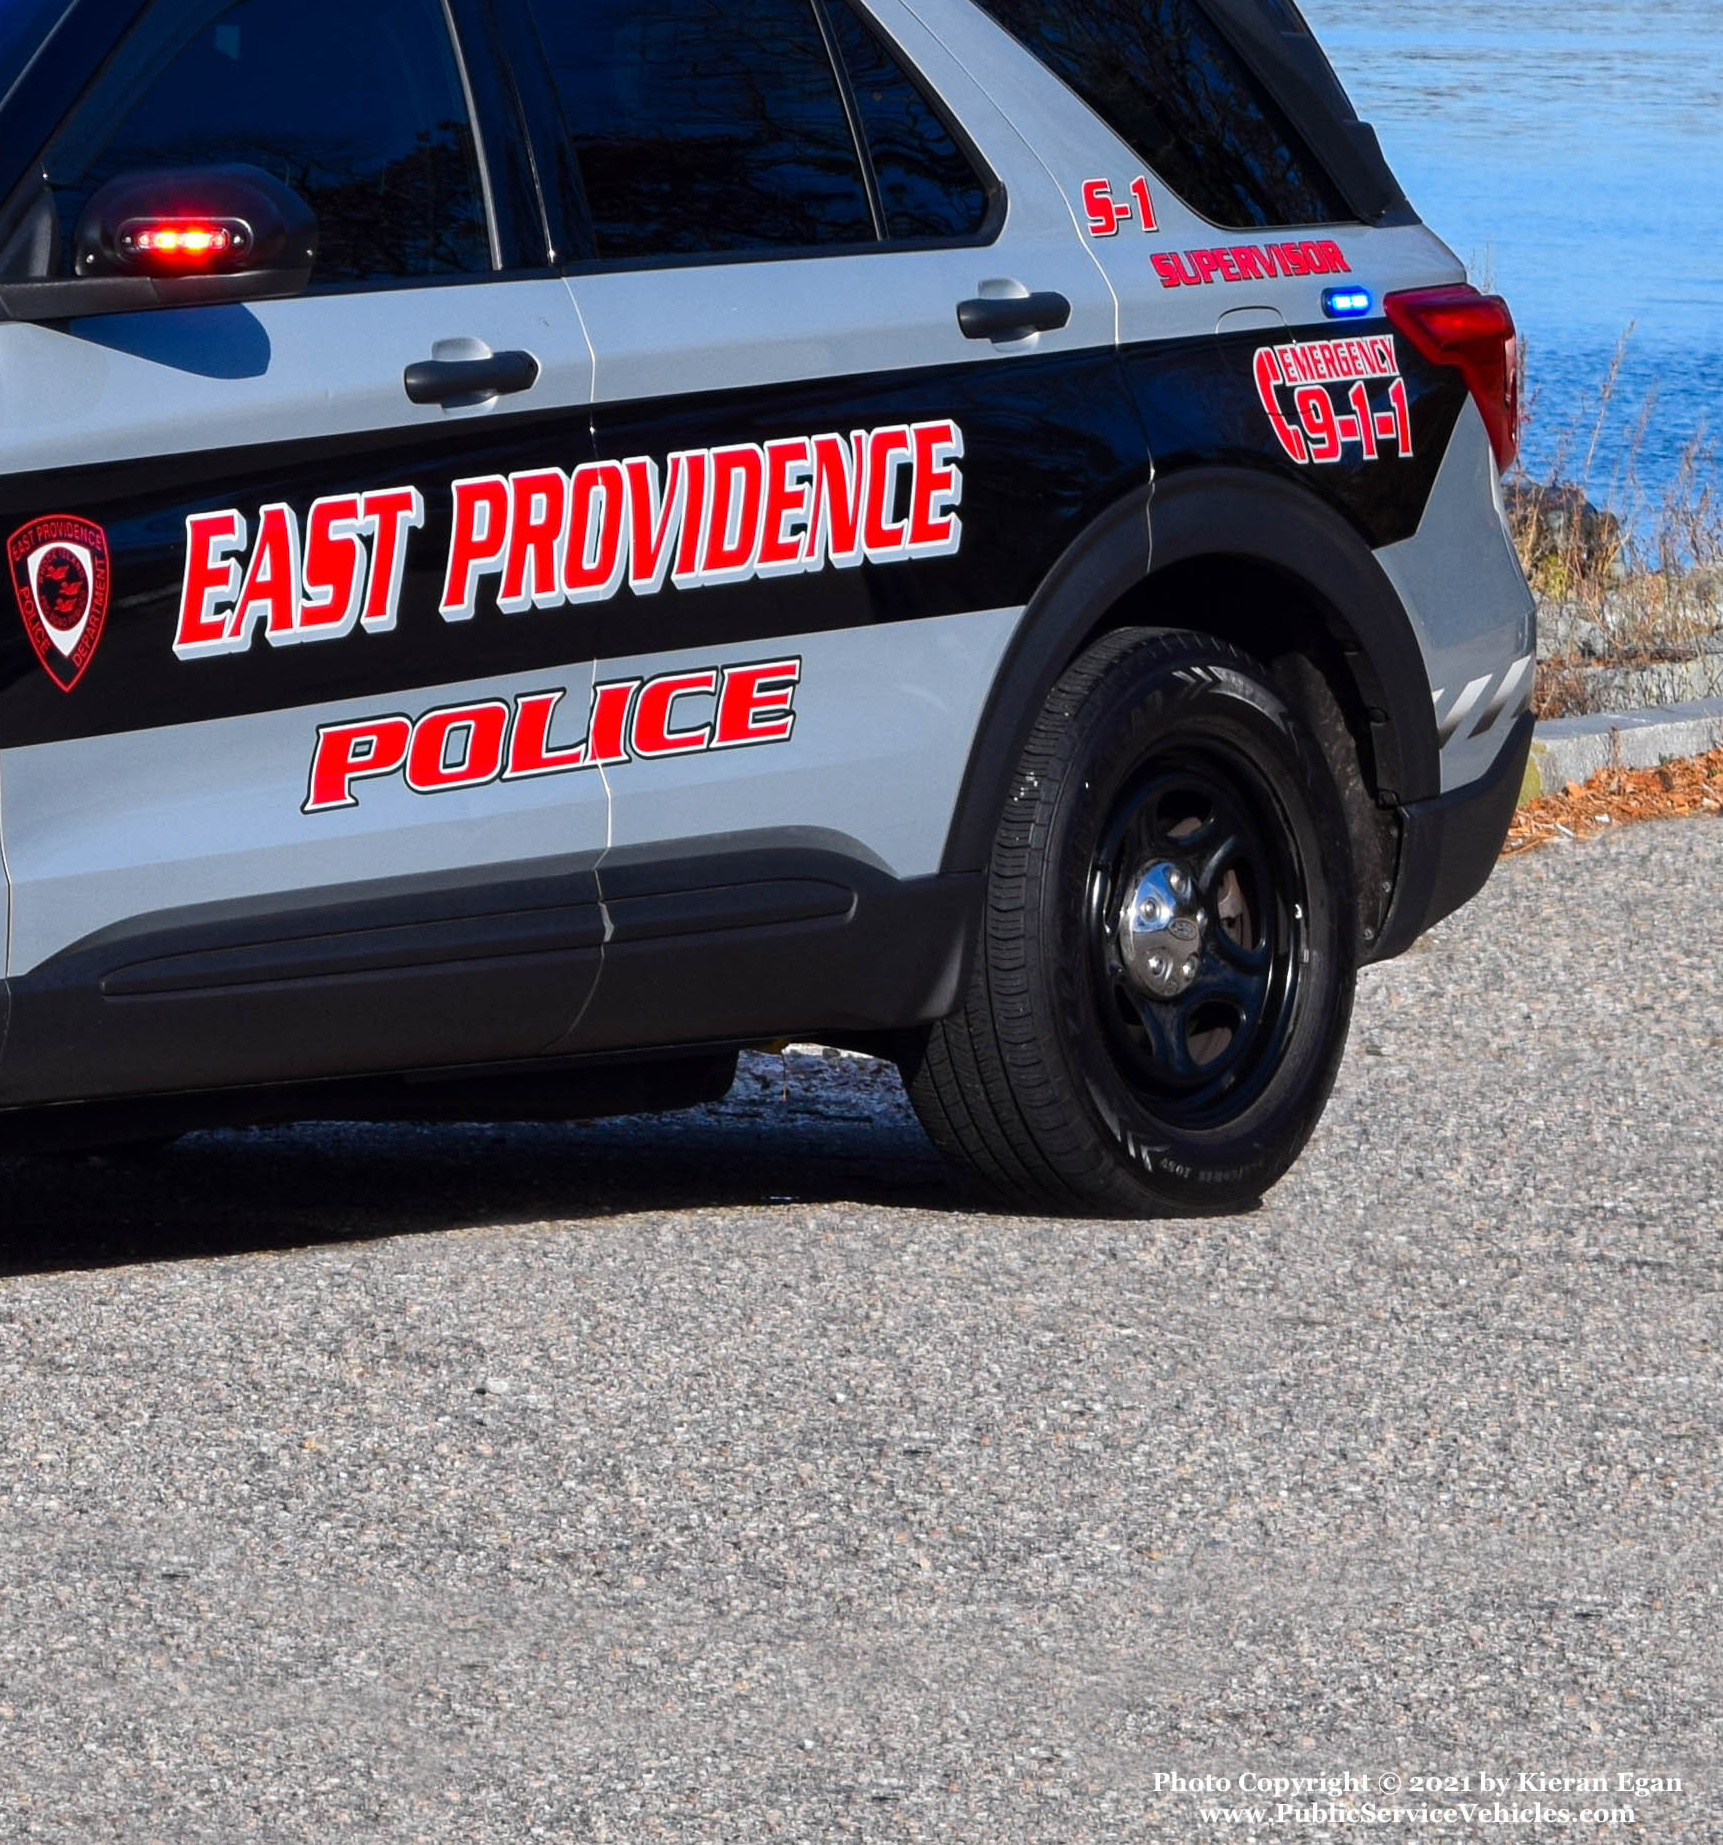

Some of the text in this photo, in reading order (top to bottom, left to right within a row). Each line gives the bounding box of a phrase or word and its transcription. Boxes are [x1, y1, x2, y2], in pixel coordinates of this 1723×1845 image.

[1081, 174, 1159, 237] S-1
[1150, 240, 1352, 288] SUPERVISOR
[1278, 334, 1399, 384] EMERGENCY
[1293, 377, 1413, 465] 9-1-1
[12, 521, 103, 561] EAST PROVIDENCE
[171, 418, 964, 661] EAST PROVIDENCE
[19, 586, 52, 654] POLICE
[72, 556, 105, 667] DEPARTMENT
[300, 655, 802, 814] POLICE
